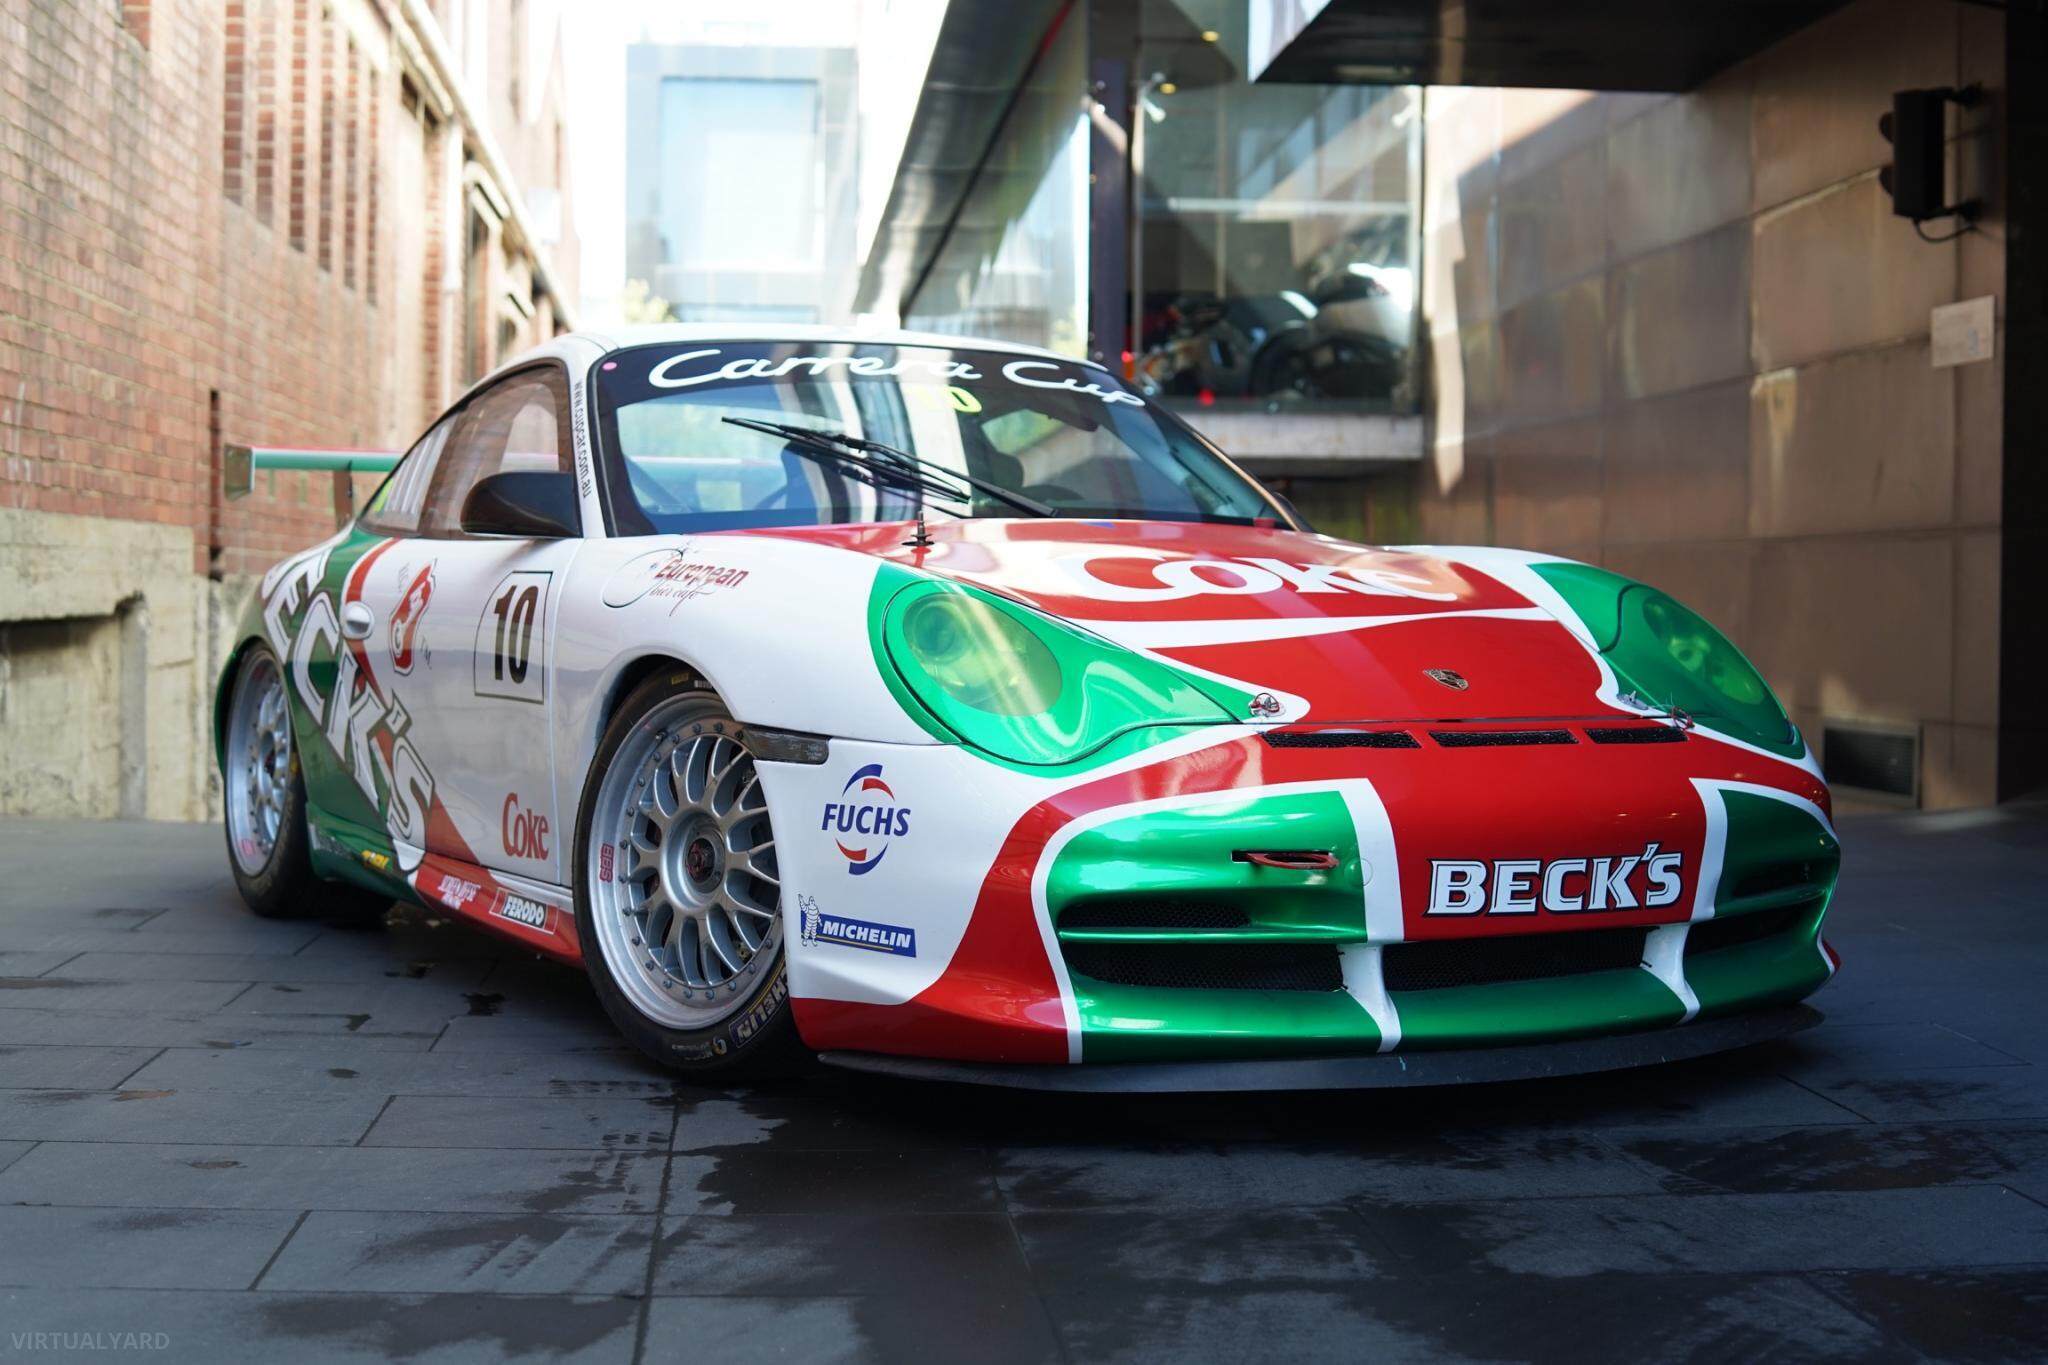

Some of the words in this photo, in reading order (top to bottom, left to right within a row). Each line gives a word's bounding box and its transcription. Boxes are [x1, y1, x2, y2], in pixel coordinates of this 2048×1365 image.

[649, 348, 982, 388] Carrera
[1002, 361, 1146, 407] Cup
[574, 382, 592, 499] www.cupcar.com.au
[655, 558, 749, 587] European
[1066, 556, 1457, 602] Coke
[494, 584, 539, 684] 10
[502, 792, 549, 861] Coke
[821, 803, 911, 837] FUCHS
[1424, 842, 1683, 915] BECK'S
[503, 896, 545, 926] FERODO
[822, 920, 911, 948] MICHELIN
